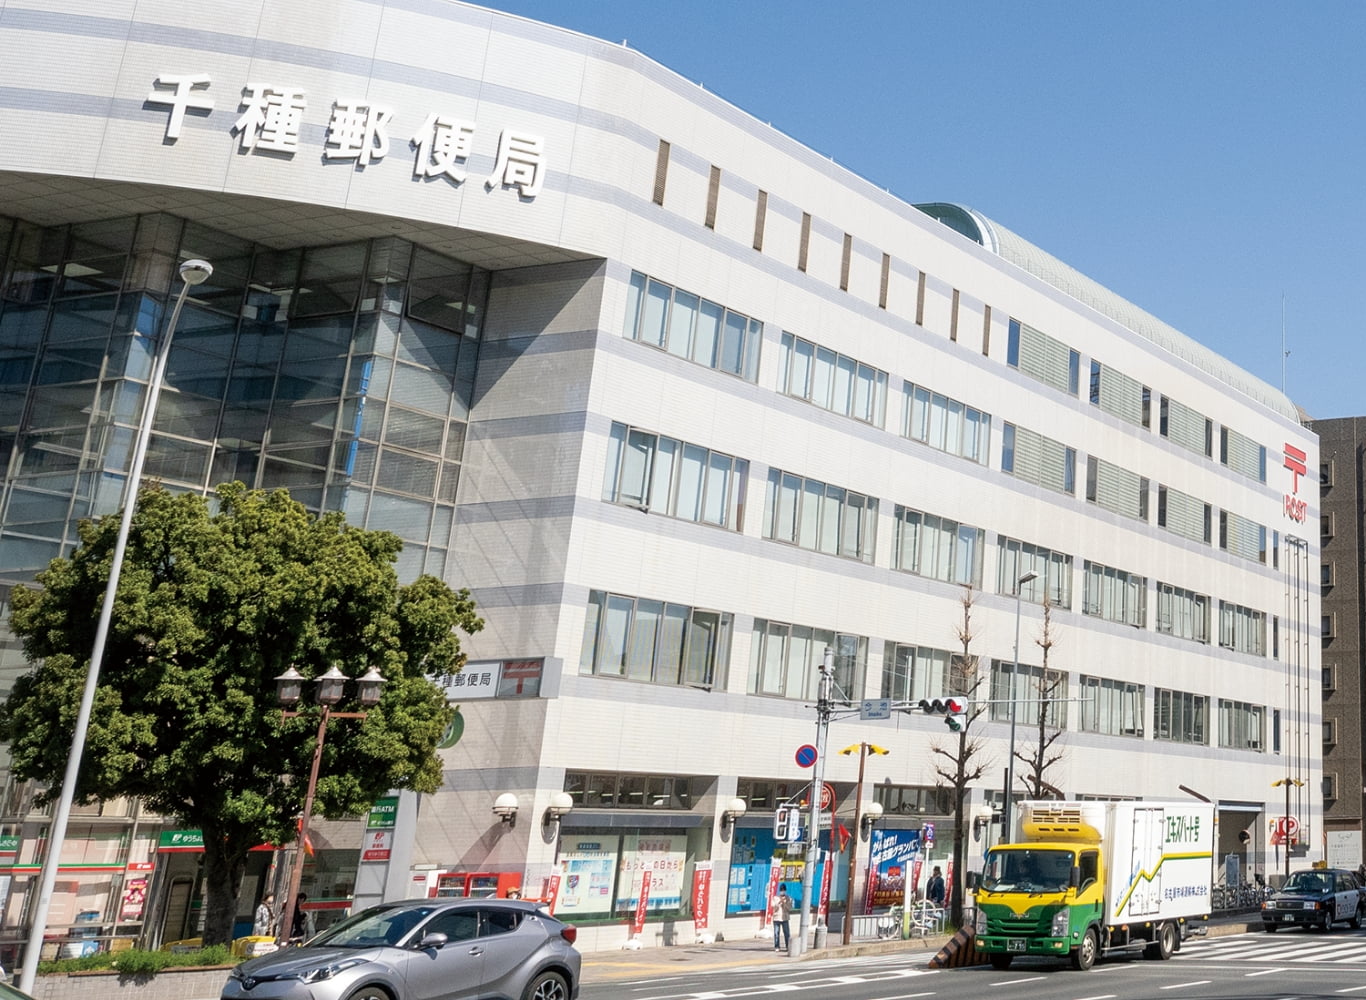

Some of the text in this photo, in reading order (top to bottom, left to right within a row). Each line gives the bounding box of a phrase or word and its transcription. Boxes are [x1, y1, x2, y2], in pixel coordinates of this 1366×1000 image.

[143, 72, 547, 200] 千種郵便局
[1285, 494, 1307, 522] POST
[1165, 815, 1200, 843] エキスパート号
[626, 859, 679, 871] もっとの日から
